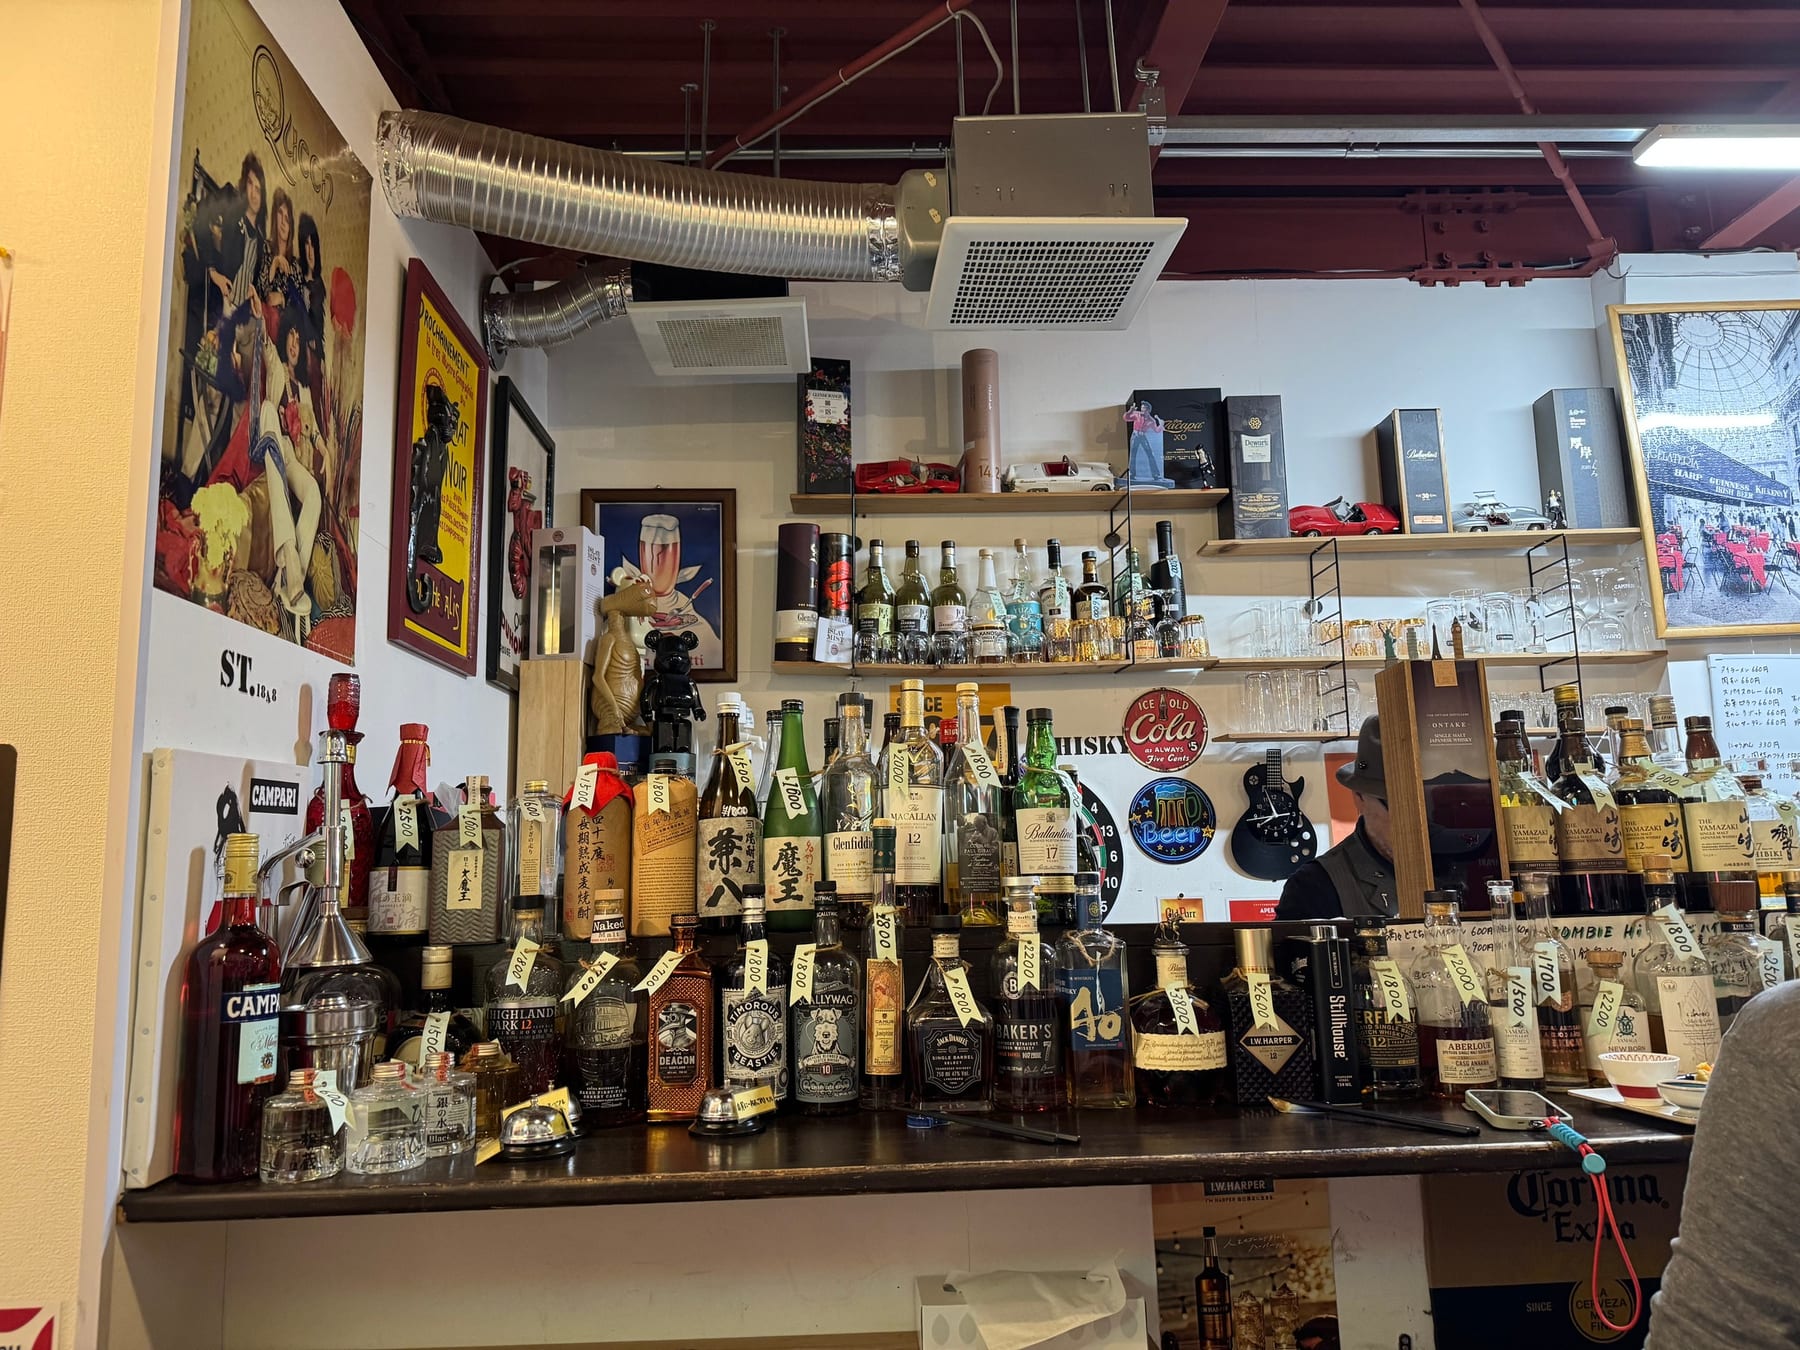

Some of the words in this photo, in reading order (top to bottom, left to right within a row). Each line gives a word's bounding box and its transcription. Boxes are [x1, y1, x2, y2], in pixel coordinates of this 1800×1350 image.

[445, 449, 467, 500] NOIR
[979, 465, 991, 478] 14
[1674, 468, 1703, 481] HARP
[1709, 477, 1750, 492] GUINNESS
[1755, 485, 1789, 499] KILKENNY
[1715, 486, 1734, 497] IRISH
[1736, 490, 1754, 499] BEER
[1014, 607, 1033, 615] YUZA
[826, 633, 844, 643] MIST
[827, 626, 845, 637] ISLAY
[1138, 700, 1155, 712] ICE
[1129, 714, 1197, 744] Cola
[1055, 736, 1130, 756] HISKY
[1452, 736, 1473, 744] WHISKY
[1155, 746, 1184, 754] ALWAYS
[970, 753, 992, 780] 1800
[1146, 755, 1165, 764] Five
[1167, 754, 1190, 763] Cents
[733, 755, 750, 784] 1500
[893, 753, 905, 784] 2000
[252, 784, 297, 809] CAMPARI
[577, 777, 591, 803] 1500
[652, 780, 665, 804] 1800
[781, 780, 803, 811] 1600
[523, 797, 541, 818] 1600
[1090, 802, 1099, 814] 4
[399, 806, 413, 837] 2500
[890, 812, 937, 822] MACALLAN
[1100, 825, 1115, 837] 13
[1140, 821, 1201, 845] Beer
[1513, 829, 1549, 837] YAMAZAKI
[1565, 827, 1603, 835] YAMAZAKI
[1604, 809, 1623, 855] 山崎
[1661, 811, 1684, 860] 山崎
[1698, 823, 1739, 831] YAMAZAKI
[907, 832, 922, 845] 12
[1634, 841, 1645, 851] 12
[1046, 847, 1058, 860] 17
[1109, 851, 1118, 863] 6
[576, 815, 592, 920] 長期熟成麦焼酎
[772, 841, 804, 904] 魔王
[1104, 876, 1119, 889] 10
[1100, 900, 1108, 913] 5
[1165, 907, 1180, 919] Old
[1180, 906, 1197, 919] Parr
[592, 921, 625, 933] Naked
[1665, 921, 1693, 954] 1800
[512, 954, 528, 980] 1800
[749, 953, 763, 983] 1800
[1024, 945, 1035, 979] 2200
[795, 958, 808, 988] 1800
[1450, 959, 1475, 992] 2000
[1540, 953, 1556, 993] 1700
[1382, 973, 1403, 1010] 1800
[1512, 981, 1527, 1018] 1500
[952, 986, 972, 1015] 1800
[1170, 991, 1190, 1024] 3800
[1253, 983, 1270, 1019] 2600
[490, 1008, 555, 1021] HIGHLAND
[729, 1000, 780, 1022] TIMOROUS
[1596, 993, 1615, 1029] 2200
[490, 1020, 519, 1032] PARK
[520, 1019, 533, 1030] 12
[996, 1023, 1053, 1040] BAKER'S
[1329, 995, 1349, 1060] Stillhouse
[936, 1035, 949, 1047] JACK
[948, 1033, 968, 1047] DANIEL'S
[1250, 1037, 1293, 1046] I.W.HARPER
[1371, 1036, 1387, 1048] 12
[659, 1055, 696, 1067] DEACON
[733, 1048, 778, 1069] BEASTIE
[1269, 1051, 1278, 1060] 12
[821, 1065, 831, 1075] 10
[1210, 1179, 1266, 1192] I.W.HARPER
[1526, 1301, 1553, 1313] SINCE
[1591, 1321, 1611, 1332] FIN
